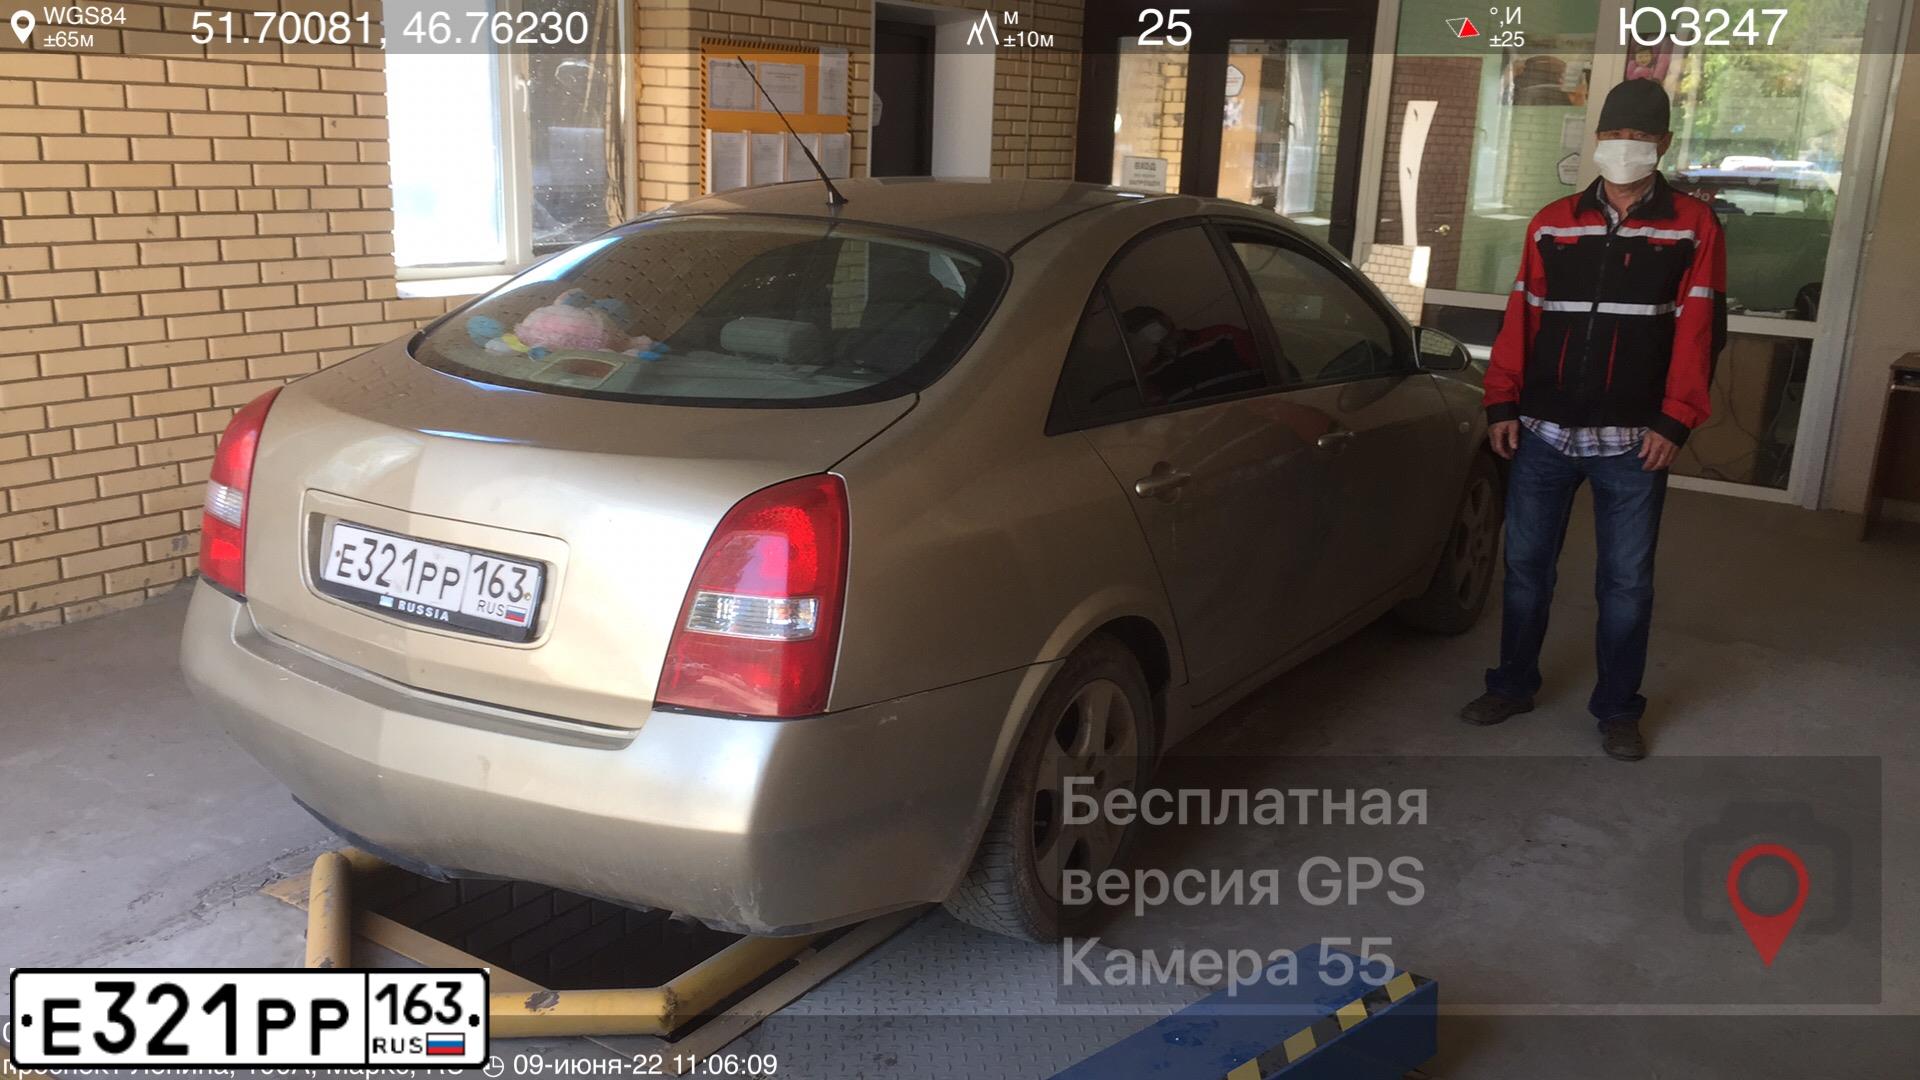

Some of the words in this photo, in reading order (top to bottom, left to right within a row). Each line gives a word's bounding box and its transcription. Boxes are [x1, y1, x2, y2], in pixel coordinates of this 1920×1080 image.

[473, 560, 528, 603] 163
[397, 600, 450, 622] RUSSIA
[477, 599, 505, 617] RUS
